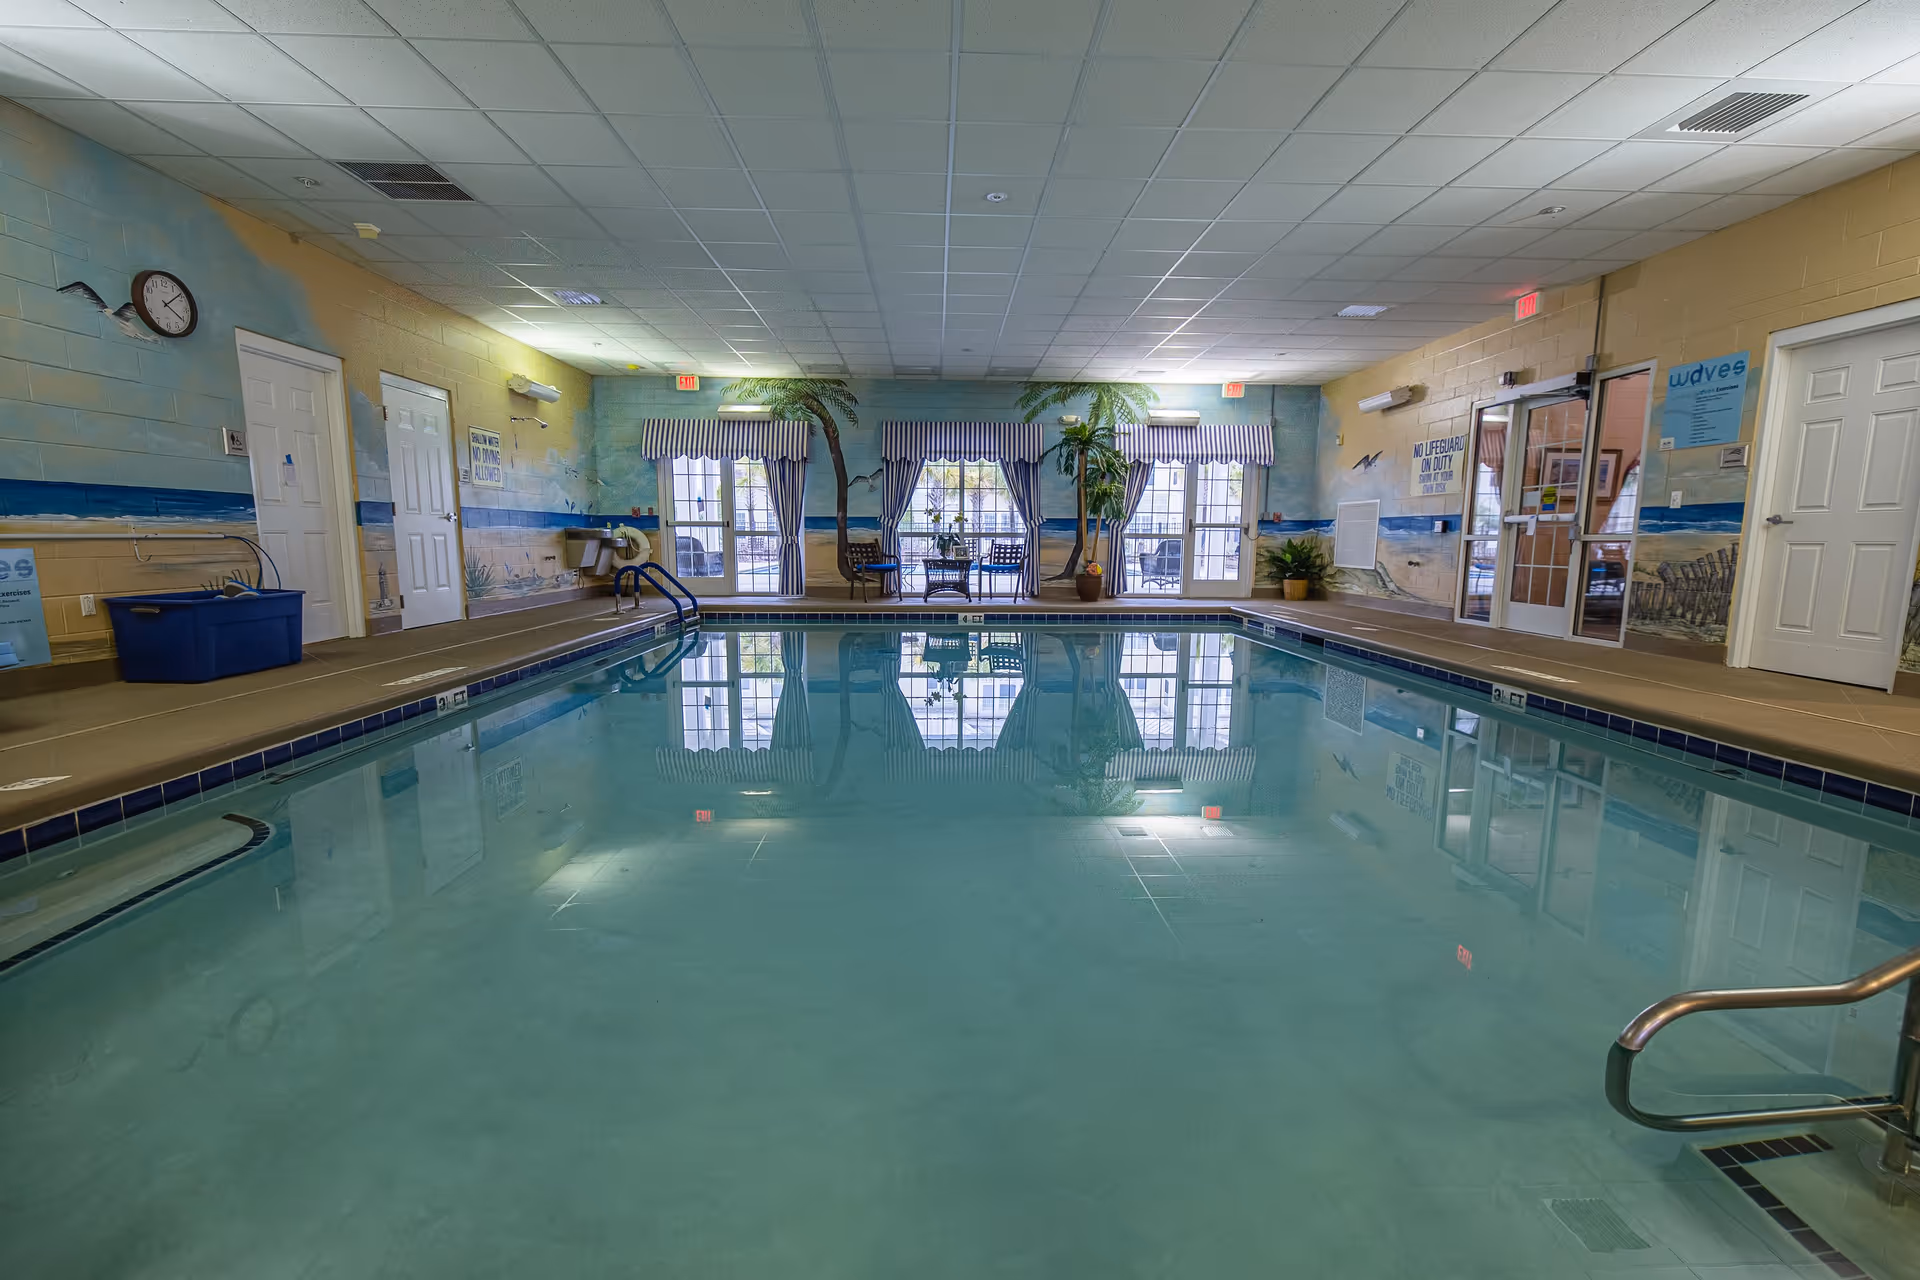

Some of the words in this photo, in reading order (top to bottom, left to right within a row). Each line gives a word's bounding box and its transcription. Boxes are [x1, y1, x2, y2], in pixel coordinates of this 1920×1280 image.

[161, 279, 168, 288] 12
[1518, 293, 1537, 319] EXIT
[680, 376, 695, 389] EXIT
[1669, 360, 1746, 388] waves
[1227, 383, 1243, 396] EXIT
[471, 432, 487, 445] SHALLOW
[487, 435, 499, 448] WATER
[1413, 442, 1423, 458] NO
[1425, 435, 1465, 456] LIFEGUARD
[472, 445, 481, 463] NO
[482, 447, 500, 466] DIVING
[1421, 457, 1431, 473] ON
[1433, 454, 1453, 471] DUTY
[475, 465, 501, 483] ALLOWED
[0, 590, 31, 598] xercises
[1510, 692, 1525, 708] FT
